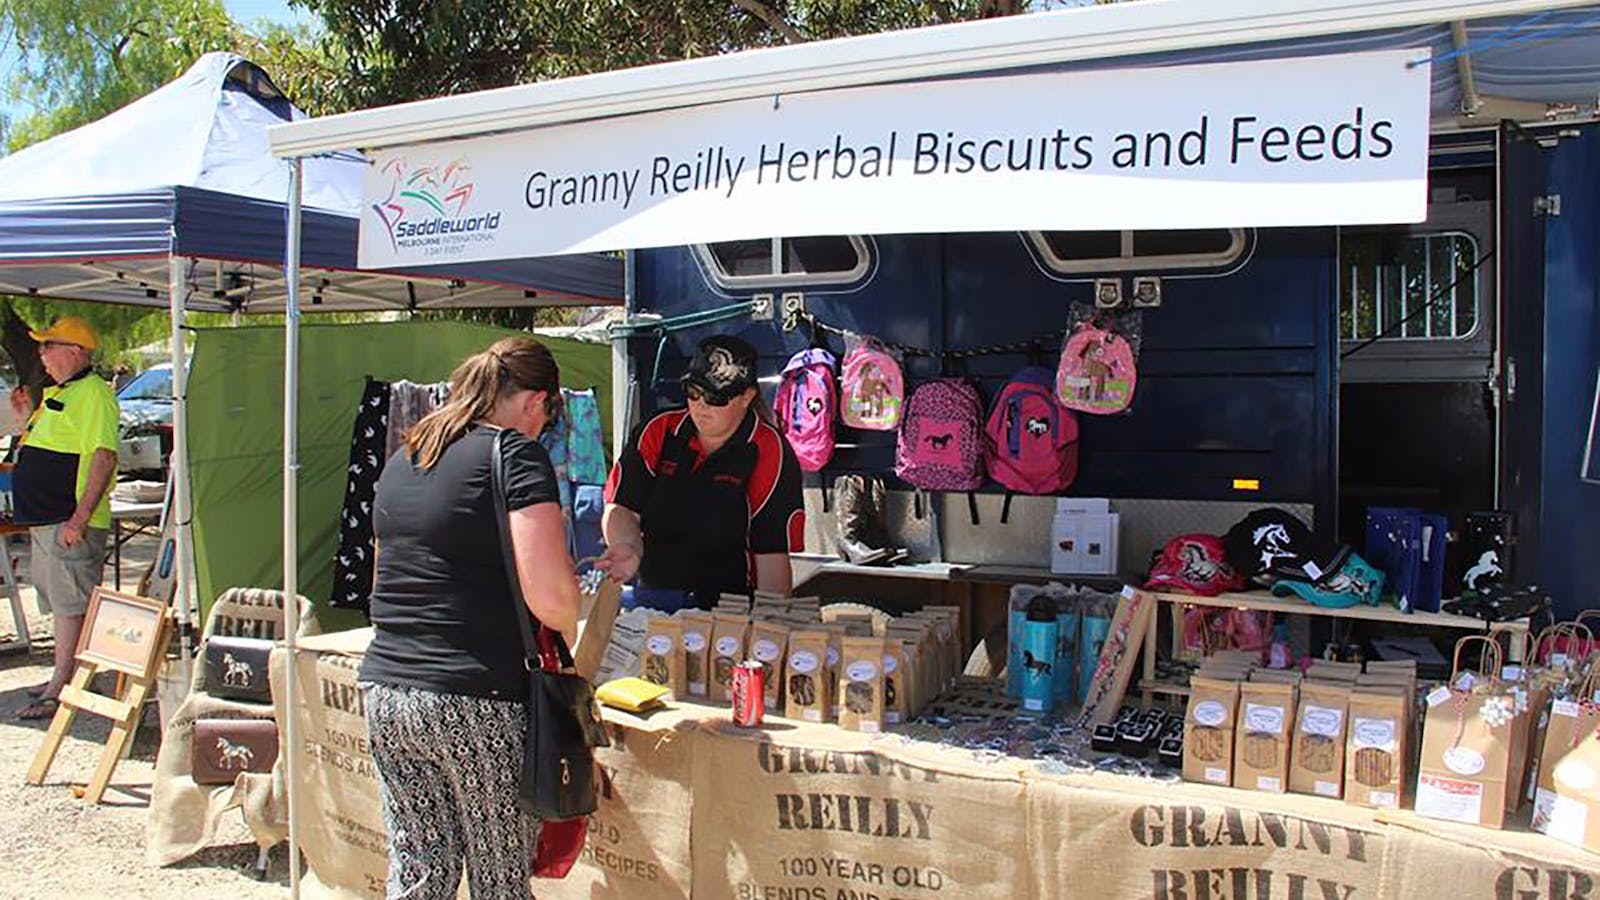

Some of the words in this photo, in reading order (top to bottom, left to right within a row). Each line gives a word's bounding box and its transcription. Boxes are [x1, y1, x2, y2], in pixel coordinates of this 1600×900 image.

[525, 169, 641, 210] Granny
[650, 146, 746, 197] Reilly
[757, 131, 899, 185] Herbal
[914, 129, 1093, 174] Biscuits
[1112, 116, 1209, 169] and
[1230, 106, 1394, 164] Feeds
[396, 212, 501, 238] Saddleworld
[398, 237, 440, 248] MELBOURNE
[322, 677, 366, 718] REI
[348, 734, 368, 754] YE
[357, 760, 376, 780] AN
[775, 792, 934, 840] REILLY
[779, 856, 818, 877] 100
[820, 858, 885, 885] YEAR
[892, 865, 942, 891] OLD
